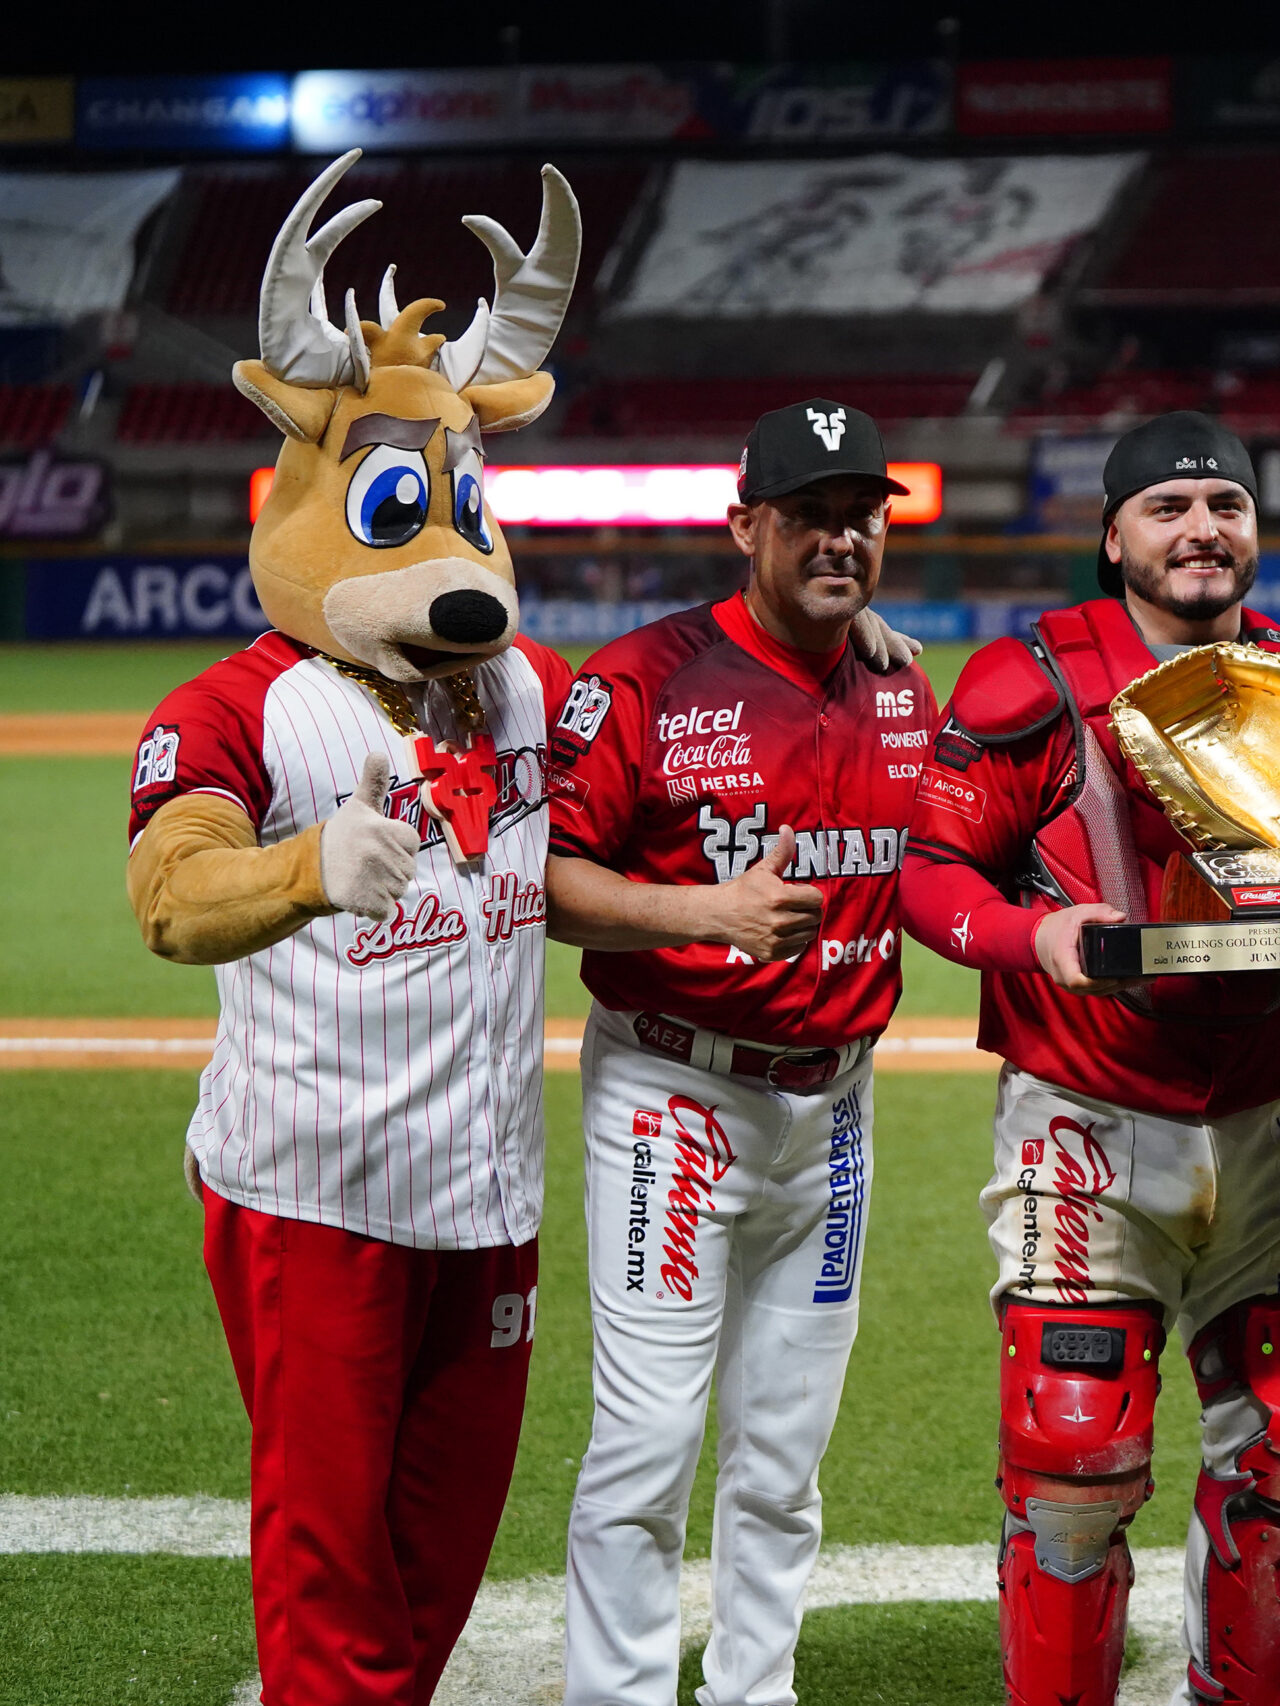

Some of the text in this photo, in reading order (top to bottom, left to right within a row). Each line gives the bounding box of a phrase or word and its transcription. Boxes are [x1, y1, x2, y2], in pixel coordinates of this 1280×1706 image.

[657, 701, 744, 742] telcel
[662, 733, 752, 776] Coca-Cola
[700, 772, 765, 791] HERSA
[934, 780, 964, 798] ARCO
[345, 892, 468, 968] Salsa
[1166, 938, 1223, 950] RAWLINGS
[1226, 937, 1257, 948] GOLD
[1176, 954, 1202, 964] ARCO
[1250, 952, 1277, 963] JUAN
[639, 1017, 688, 1052] PAEZ
[659, 1094, 738, 1302] Caliente
[821, 1097, 852, 1279] PAQUETEXPRESS
[625, 1141, 657, 1294] caliente.mx
[490, 1285, 538, 1349] 91
